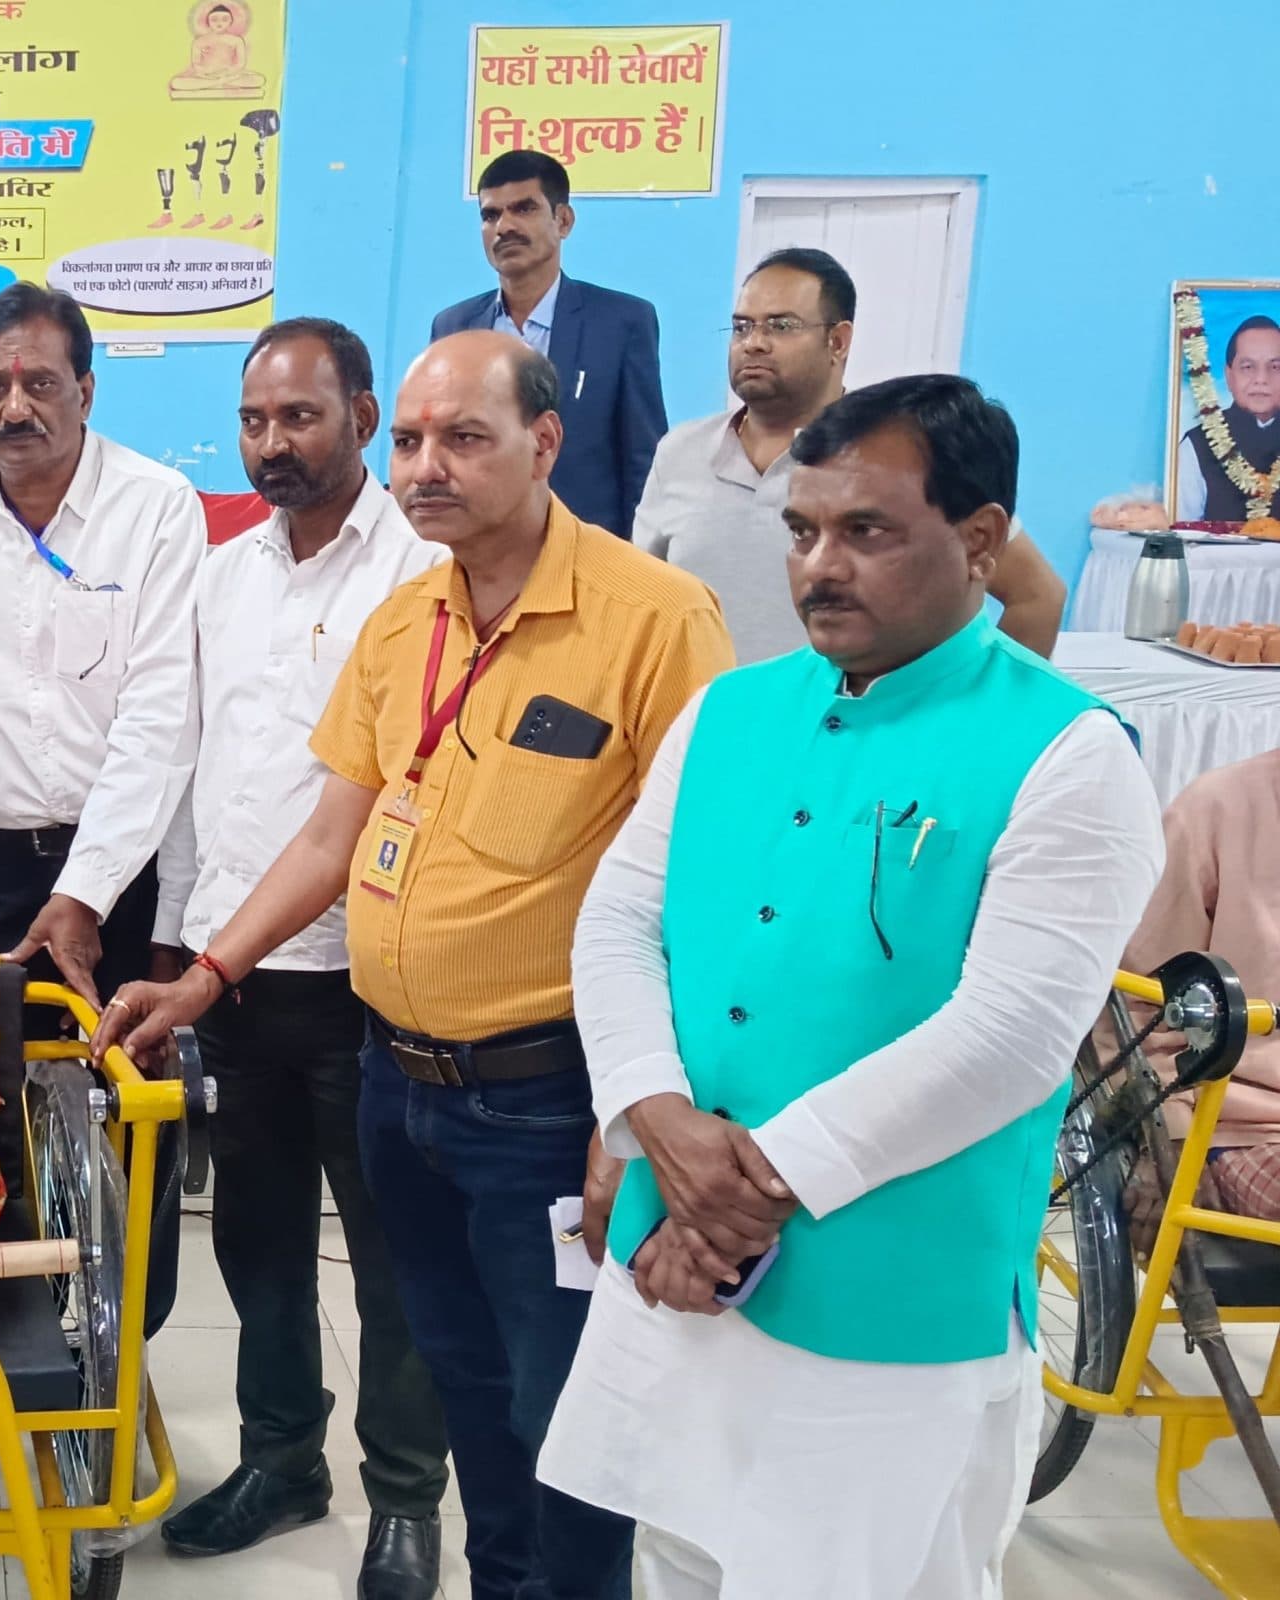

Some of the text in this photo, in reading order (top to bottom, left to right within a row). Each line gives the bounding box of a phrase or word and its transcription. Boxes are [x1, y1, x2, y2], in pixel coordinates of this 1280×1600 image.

[481, 43, 708, 85] यहाँ सभी सेवायें
[654, 102, 689, 153] हैं
[40, 128, 76, 159] में
[62, 260, 113, 273] विकलांगता
[115, 261, 143, 273] प्रमाण
[146, 261, 160, 272] पत्र
[164, 259, 181, 272] और
[215, 261, 228, 271] का
[230, 260, 254, 271] छाया
[256, 259, 272, 271] प्रति
[73, 279, 87, 292] एवं
[89, 280, 105, 292] एक
[108, 279, 131, 291] फोटो
[211, 277, 247, 290] अनिवार्य
